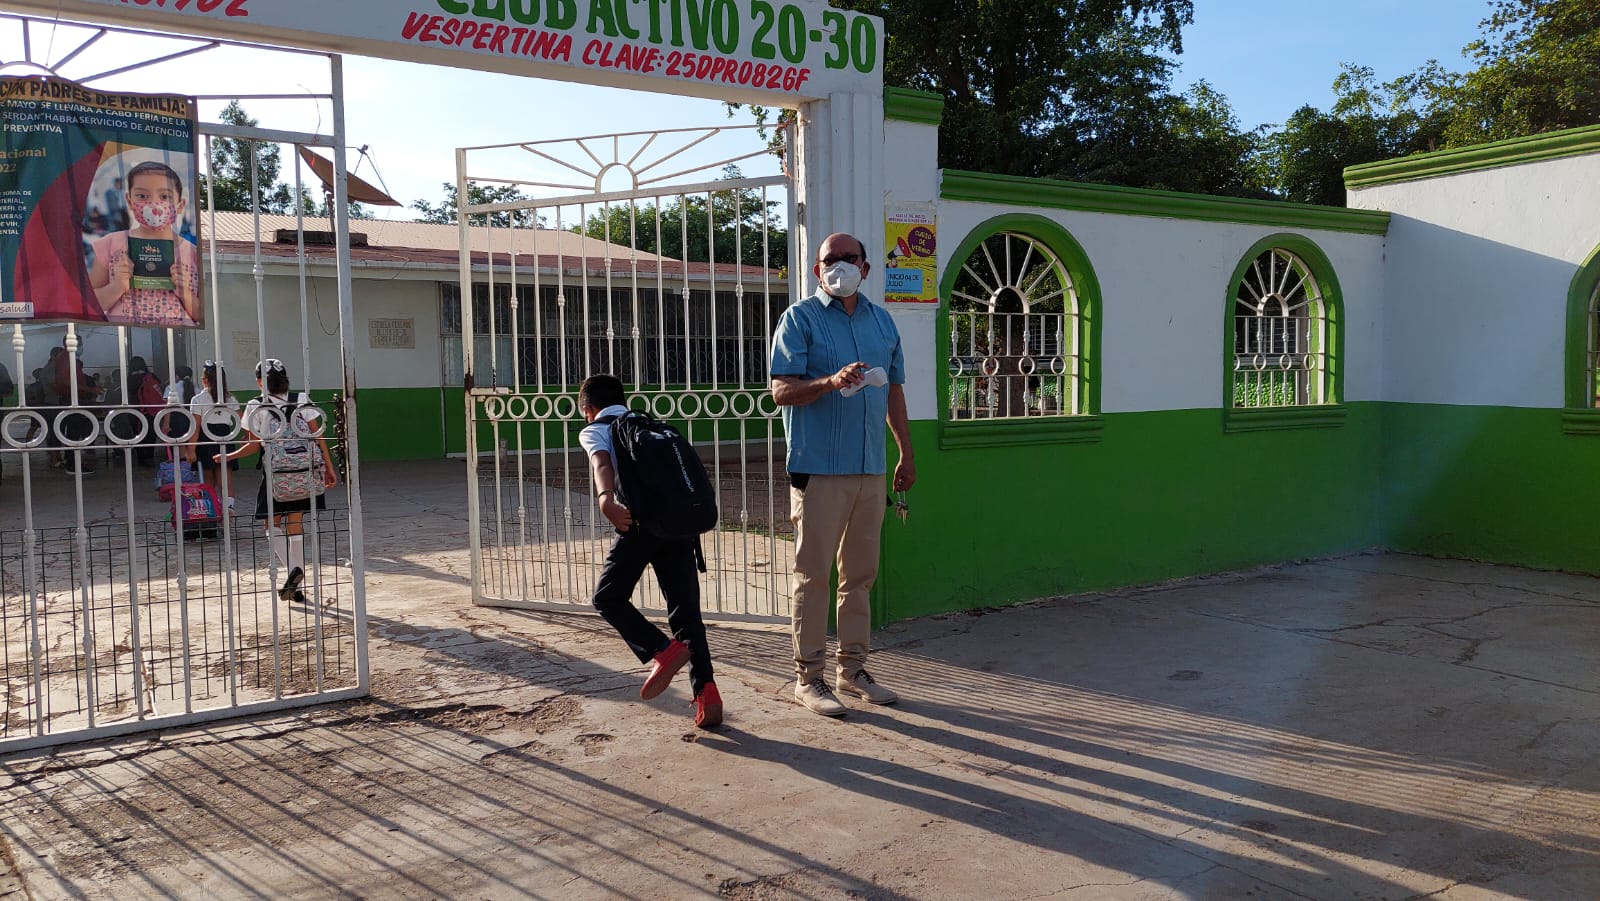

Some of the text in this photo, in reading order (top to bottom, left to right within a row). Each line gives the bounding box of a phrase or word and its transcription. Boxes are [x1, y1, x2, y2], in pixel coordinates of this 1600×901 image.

[401, 11, 573, 62] VESPERTINA
[586, 0, 740, 55] ACTIVO
[750, 0, 876, 74] 20-30
[30, 81, 92, 103] PADRES
[95, 93, 117, 108] DE
[120, 95, 186, 115] FAMILIA:
[4, 123, 63, 134] PREVENTIVA
[7, 100, 37, 110] MAYO
[41, 101, 52, 110] SE
[54, 103, 93, 114] LLEVARA
[105, 108, 132, 118] CABO
[134, 111, 160, 123] FERIA
[161, 116, 174, 125] DE
[175, 119, 187, 128] LA
[79, 116, 129, 129] SERVICIOS
[130, 122, 143, 131] DE
[144, 125, 189, 138] ATENCION
